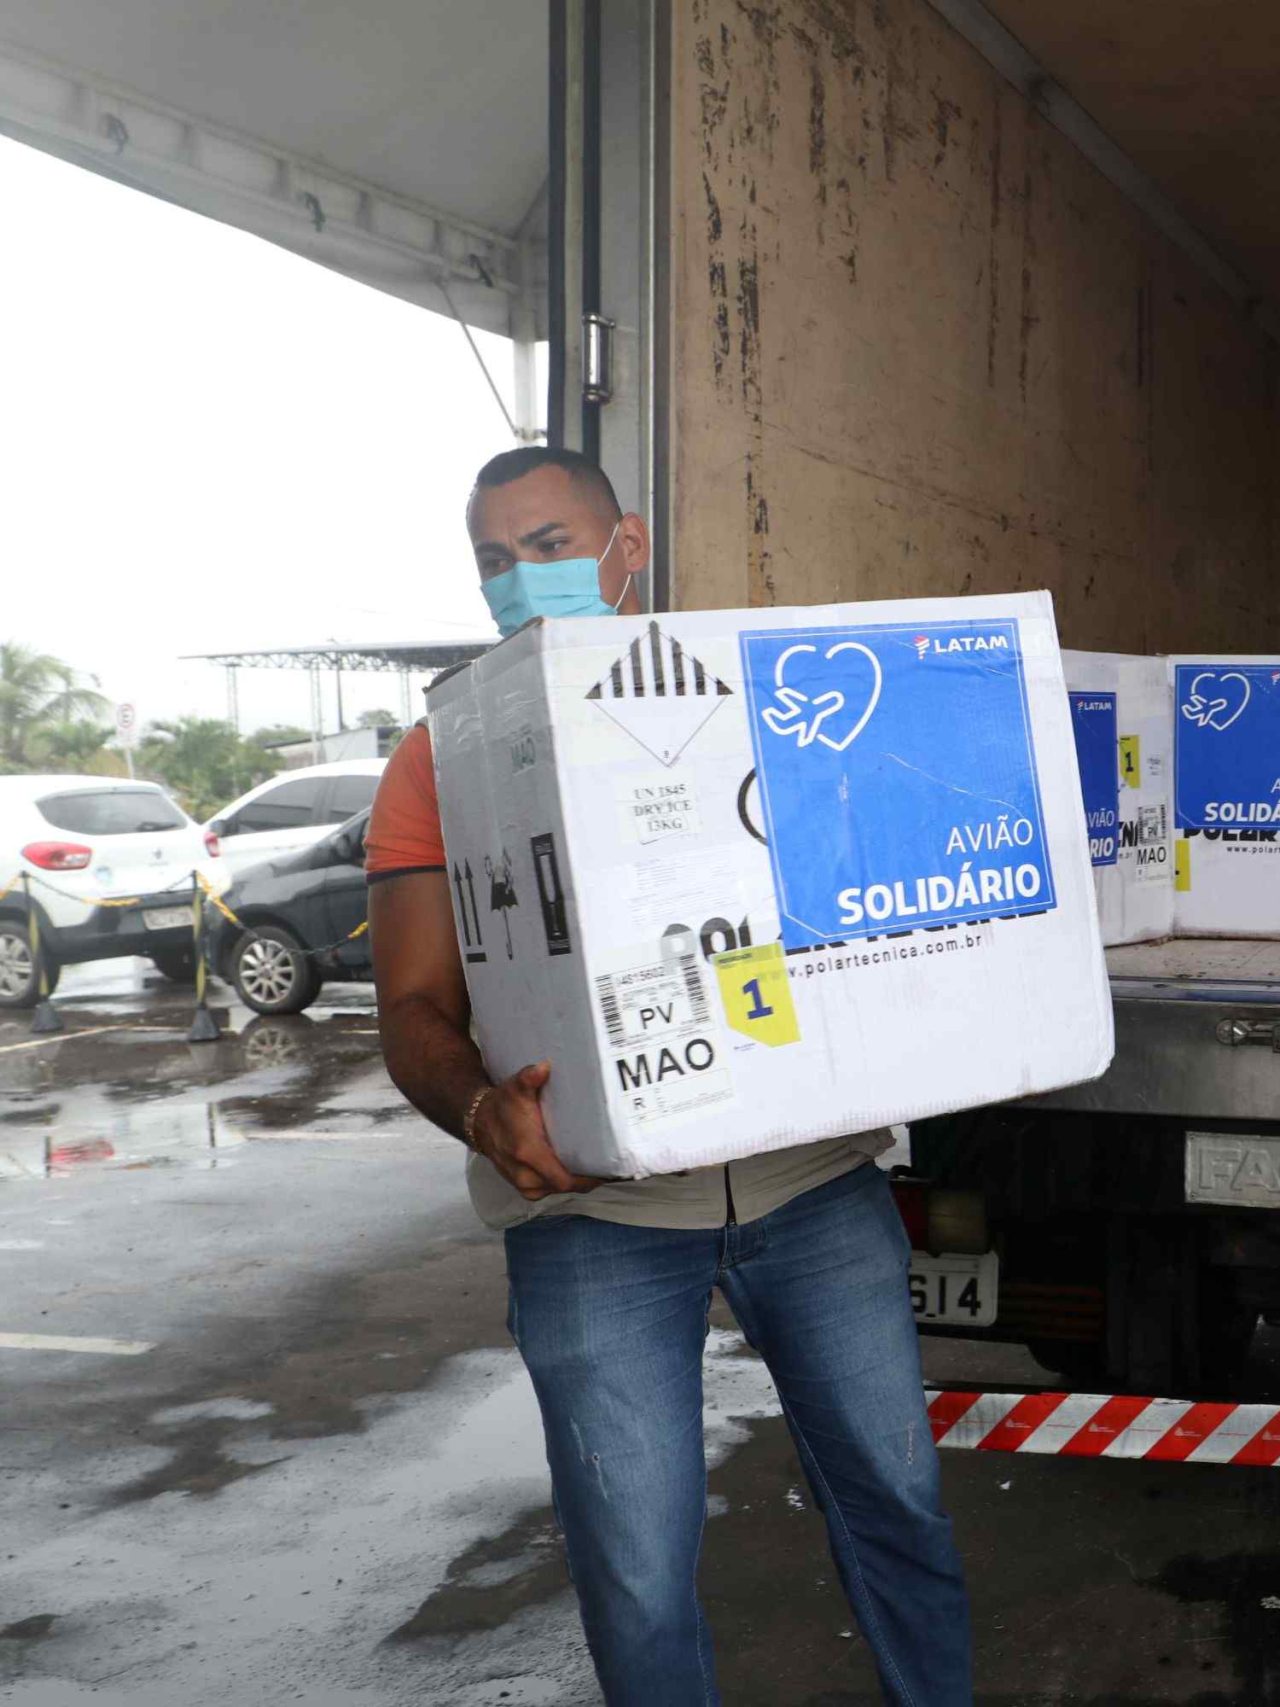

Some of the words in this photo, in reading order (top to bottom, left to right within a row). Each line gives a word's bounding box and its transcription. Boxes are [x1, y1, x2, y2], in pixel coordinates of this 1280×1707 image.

[934, 636, 1008, 653] LATAM
[1084, 702, 1112, 710] LATAM
[1125, 752, 1134, 772] 1
[634, 789, 655, 800] UN
[659, 784, 687, 798] 1845
[634, 802, 662, 816] DRY
[668, 800, 693, 812] ICE
[647, 818, 682, 832] 13KG
[1087, 808, 1115, 829] VIÃO
[946, 814, 1034, 855] AVIÃO
[1137, 846, 1167, 865] MAO
[837, 862, 1041, 925] SOLIDÁRIO
[742, 978, 773, 1020] 1
[640, 1002, 673, 1029] PV
[616, 1038, 714, 1091] MAO
[633, 1097, 646, 1111] R
